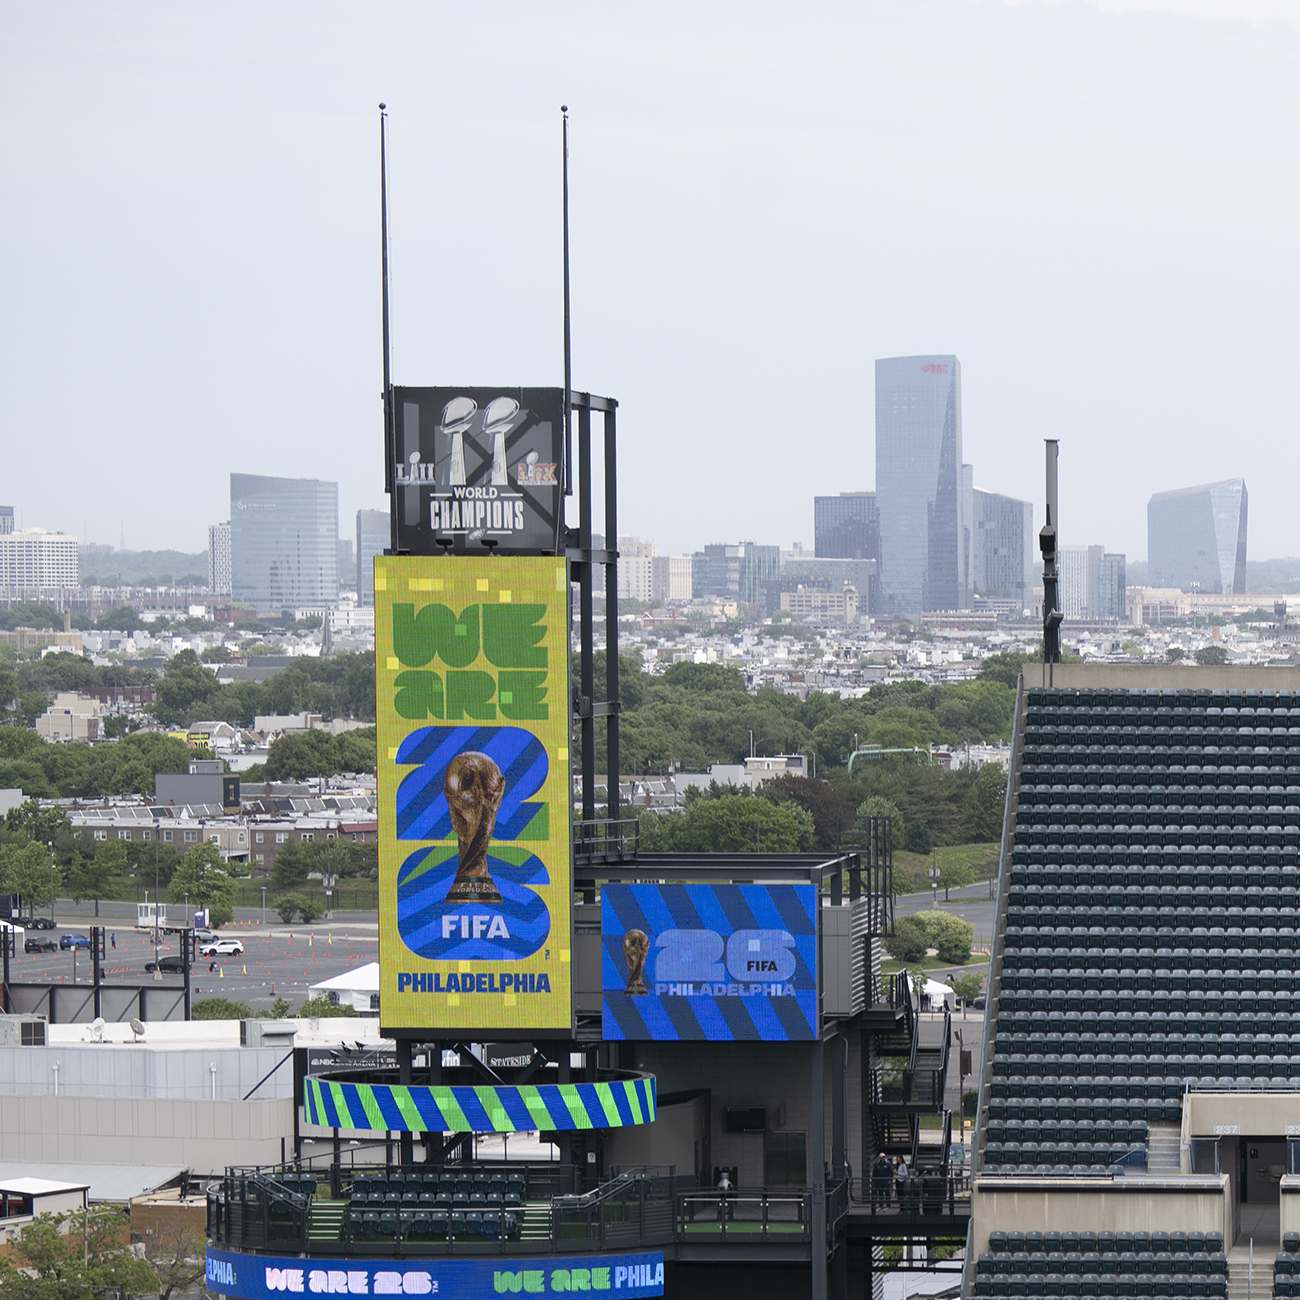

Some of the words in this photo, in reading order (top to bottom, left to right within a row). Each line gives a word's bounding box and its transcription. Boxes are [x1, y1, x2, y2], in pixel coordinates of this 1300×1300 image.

[453, 487, 498, 499] WORLD
[430, 500, 524, 530] CHAMPIONS
[393, 603, 548, 668] WE
[394, 671, 549, 720] ARE
[442, 915, 511, 939] FIFA
[655, 929, 797, 982] 26
[747, 961, 779, 972] FIFA
[397, 972, 552, 993] PHILADELPHIA
[655, 984, 797, 996] PHILADELPHIA
[490, 1054, 533, 1067] STATESIDE
[1215, 1125, 1238, 1134] 237
[265, 1267, 304, 1293] WE
[309, 1270, 368, 1294] ARE
[374, 1271, 432, 1294] 26
[494, 1270, 545, 1293] WE
[551, 1267, 610, 1292] ARE
